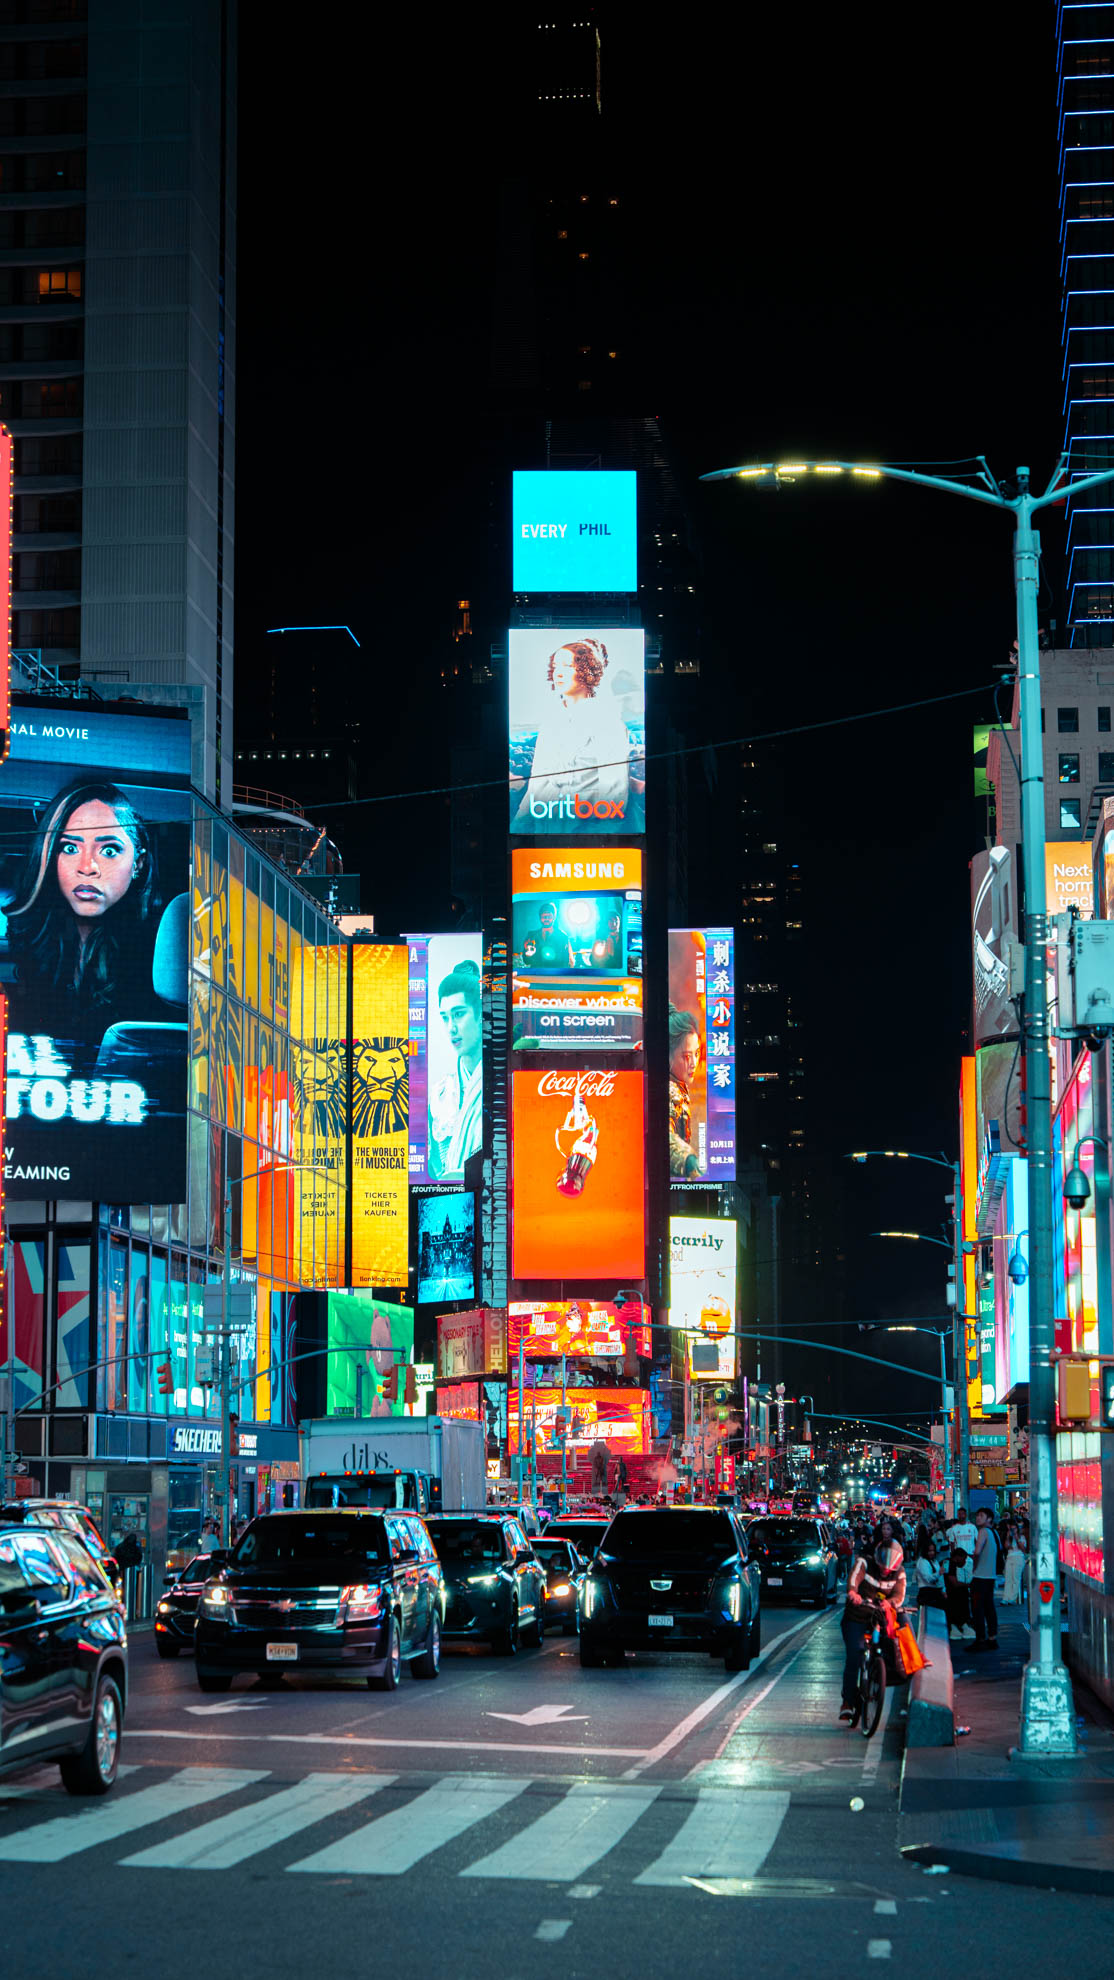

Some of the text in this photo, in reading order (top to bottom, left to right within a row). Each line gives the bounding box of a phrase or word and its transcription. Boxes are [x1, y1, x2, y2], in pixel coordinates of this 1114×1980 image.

[521, 523, 611, 538] EVERY PHIL
[42, 725, 89, 740] MOVIE
[529, 793, 624, 819] britbox
[530, 862, 625, 878] SAMSUNG
[1053, 864, 1093, 877] Next-
[409, 946, 419, 963] A
[519, 995, 636, 1009] Discover what's
[540, 1015, 615, 1026] on screen
[712, 940, 731, 1088] 刺杀小说家
[6, 1078, 149, 1124] TOUR
[356, 1147, 405, 1157] THE WORLD'S
[366, 1157, 406, 1170] MUSICAL
[670, 1232, 723, 1251] carily
[490, 1313, 503, 1371] HELLO!
[174, 1428, 222, 1454] SKECHERS
[343, 1443, 394, 1470] dibs.
